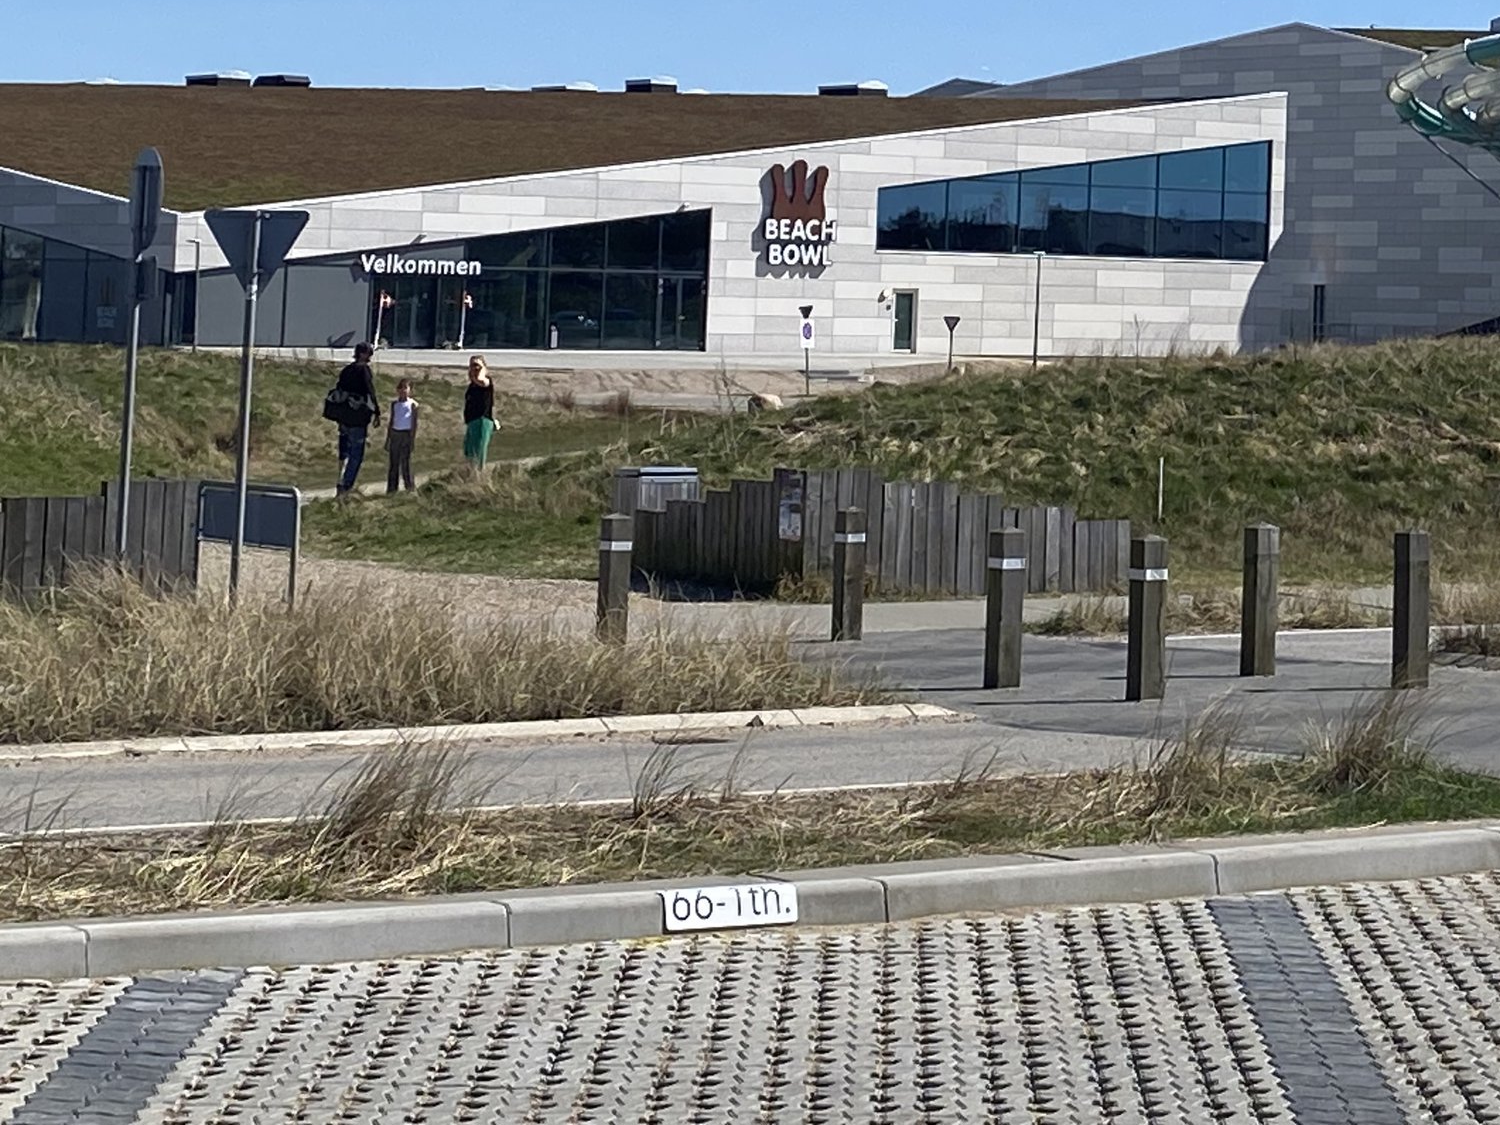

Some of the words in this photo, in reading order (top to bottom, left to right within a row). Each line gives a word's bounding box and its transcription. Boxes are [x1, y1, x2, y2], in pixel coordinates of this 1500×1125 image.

[765, 218, 836, 241] BEACH
[361, 253, 481, 275] Velkommen
[768, 243, 832, 266] BOWL
